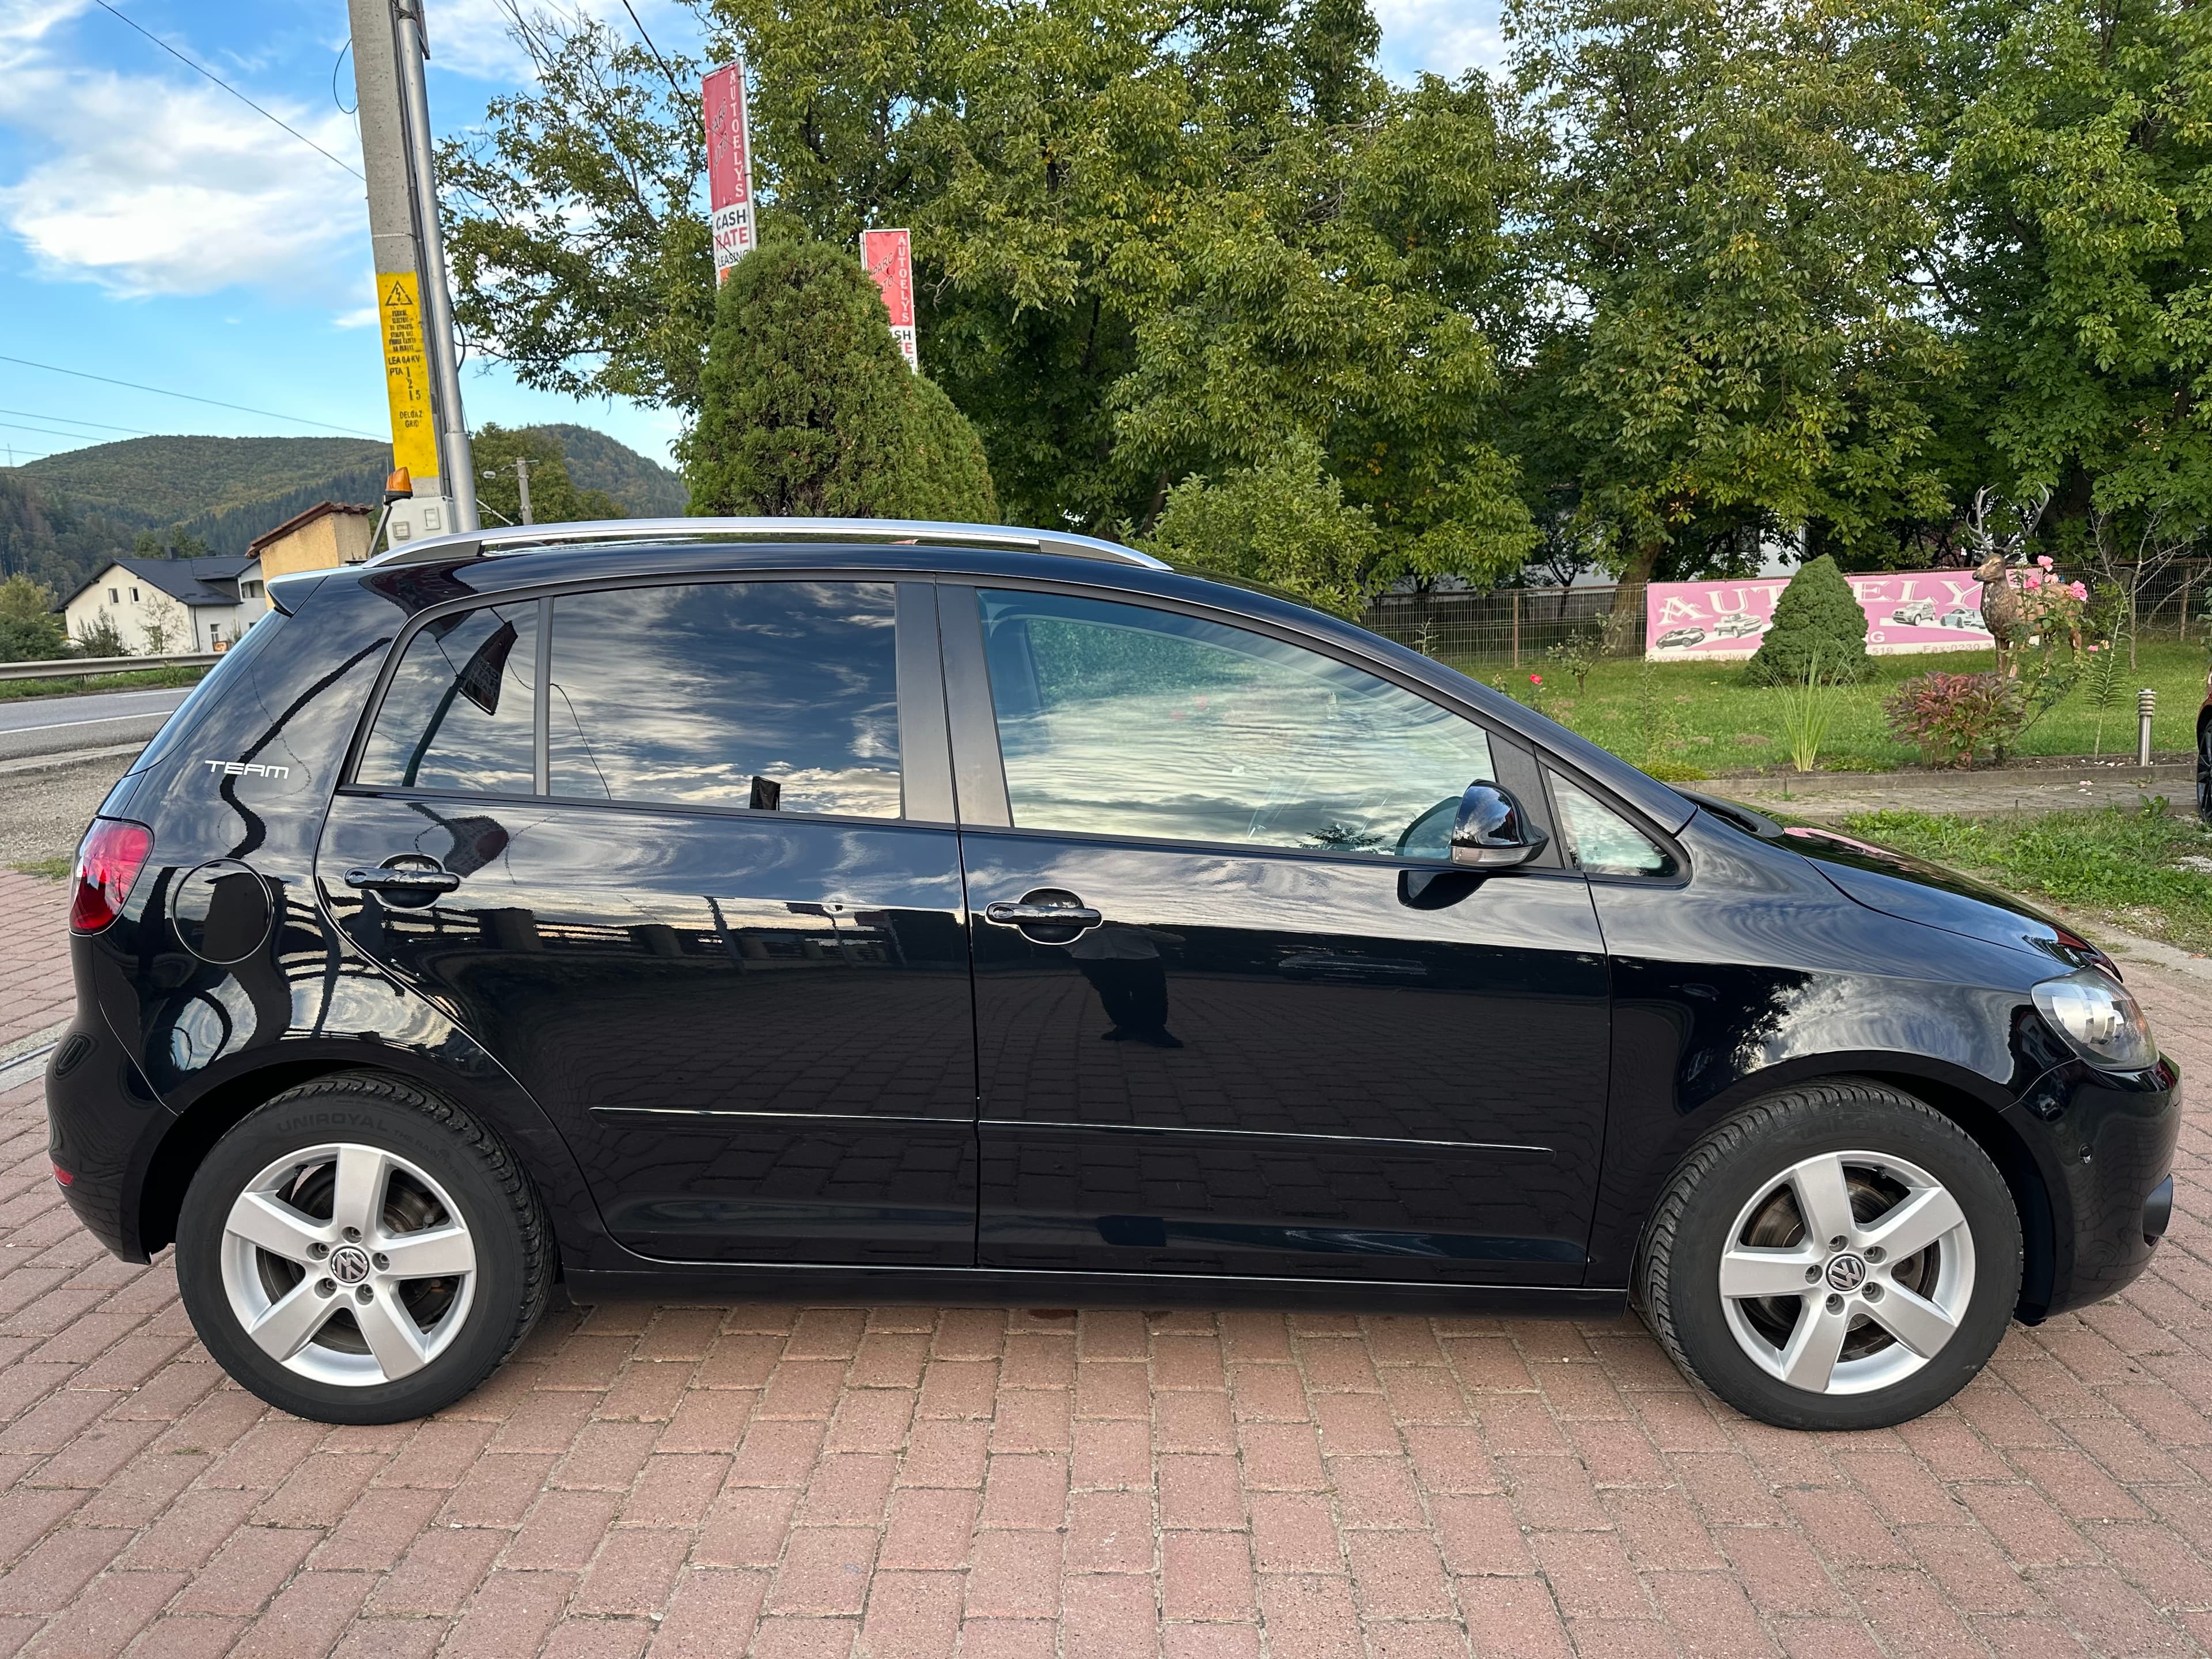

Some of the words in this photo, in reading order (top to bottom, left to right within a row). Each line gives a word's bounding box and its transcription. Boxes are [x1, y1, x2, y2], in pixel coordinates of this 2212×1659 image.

[729, 70, 744, 198] AUTOELYS
[716, 209, 746, 230] CASH
[715, 226, 749, 252] RATE
[873, 252, 893, 276] PARC
[897, 235, 910, 323] AUTOELYS
[891, 330, 911, 340] SH
[388, 357, 401, 365] LEA
[389, 368, 403, 376] PTA
[407, 378, 413, 389] 2
[400, 410, 422, 419] DELGAZ
[405, 420, 419, 428] GRID
[204, 760, 289, 779] TEAM
[277, 1112, 388, 1132] UNIROYAL
[1827, 1255, 1865, 1291] VW
